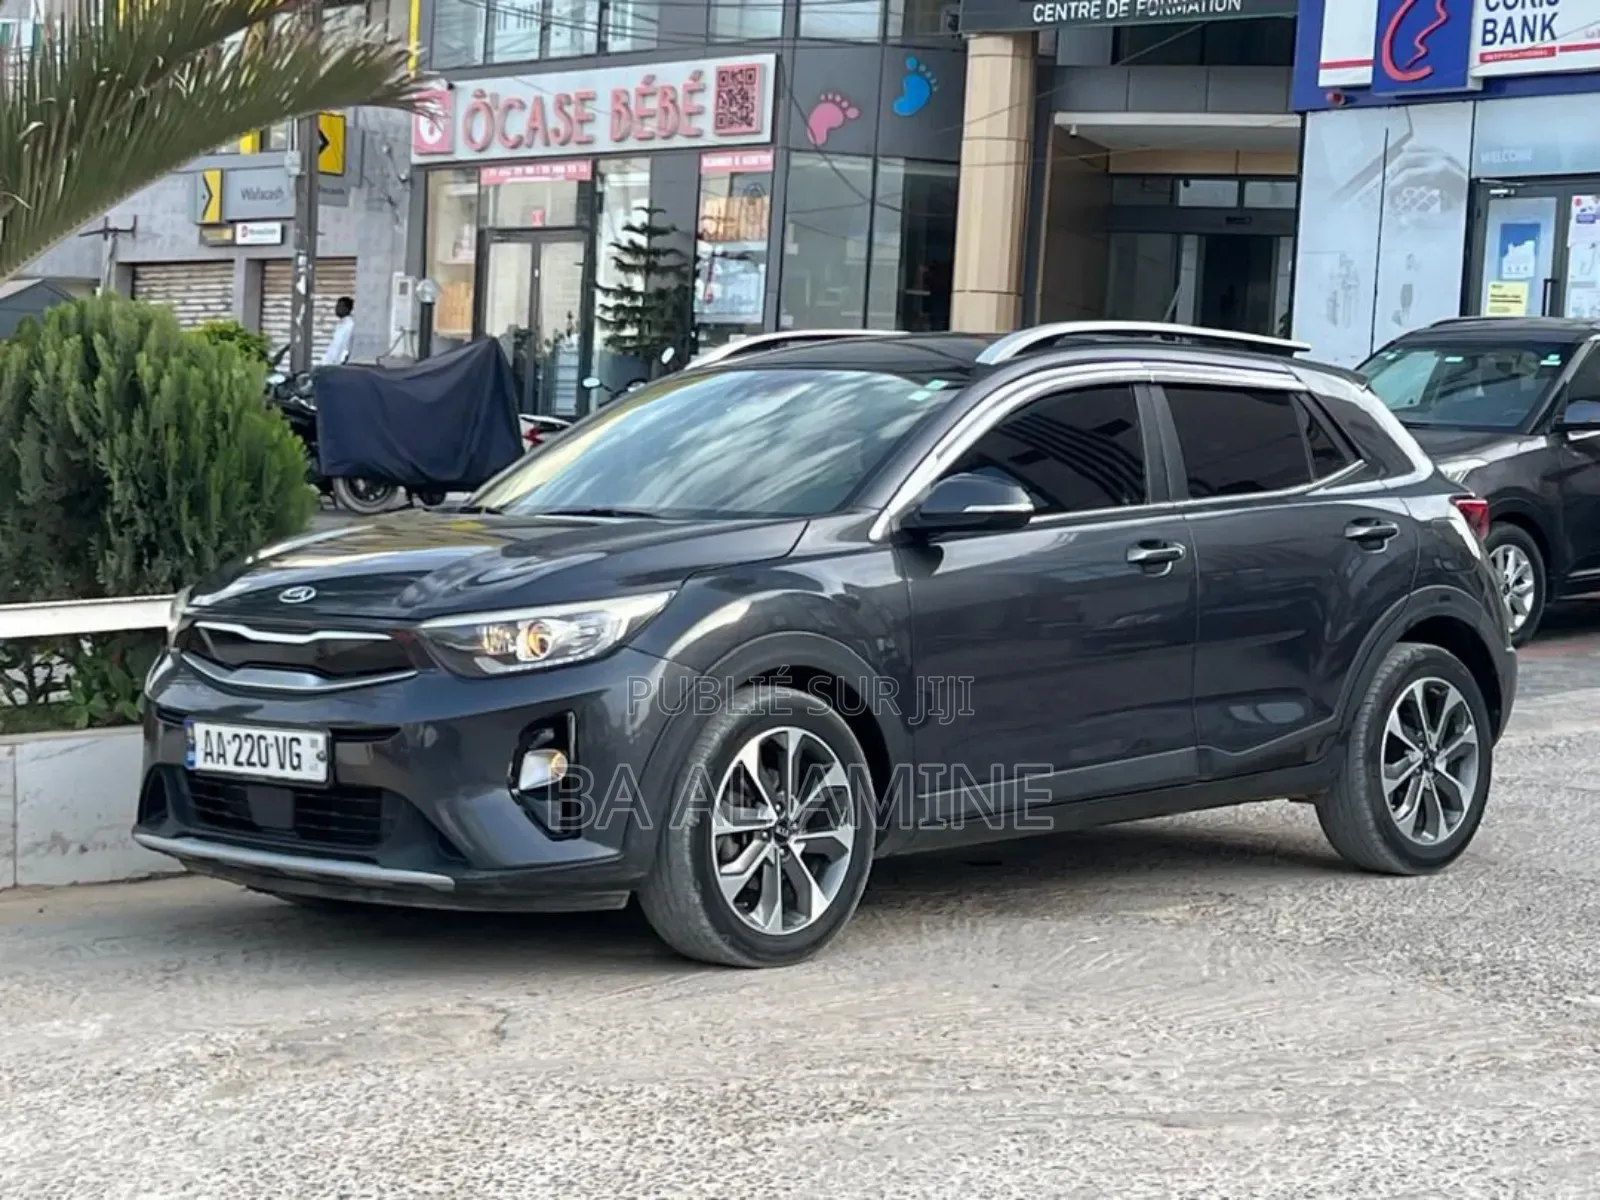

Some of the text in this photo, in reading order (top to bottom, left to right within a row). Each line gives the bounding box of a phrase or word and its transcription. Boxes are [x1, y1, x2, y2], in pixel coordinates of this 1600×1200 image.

[1033, 1, 1101, 23] CENTRE
[1106, 0, 1130, 19] DE
[1481, 12, 1558, 47] BANK
[610, 70, 706, 143] BÉBÉ
